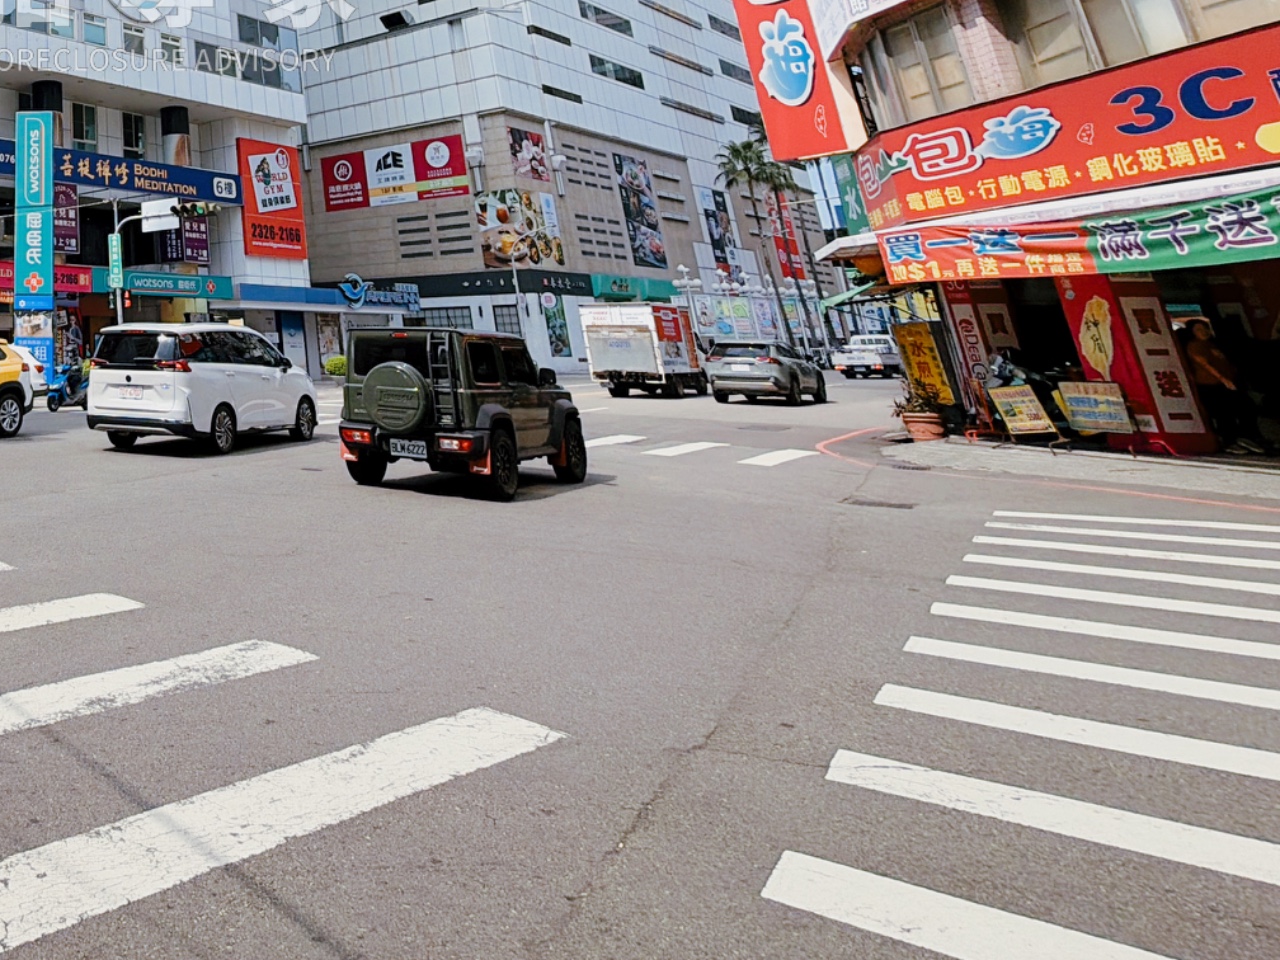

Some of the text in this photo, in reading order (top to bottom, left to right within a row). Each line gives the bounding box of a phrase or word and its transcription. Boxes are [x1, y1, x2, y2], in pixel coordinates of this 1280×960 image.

[1108, 65, 1280, 137] 3C
[29, 129, 40, 194] watsons
[59, 153, 131, 186] 菩提禪修
[133, 163, 168, 180] BODHI
[375, 150, 405, 173] ACE
[905, 135, 1228, 212] 電腦包 行動電源 鋼化玻璃貼
[133, 177, 198, 196] MEDITATION
[215, 180, 234, 196] 6樓
[251, 222, 302, 243] 2326-2166
[1087, 199, 1280, 262] 滿千送
[883, 227, 1080, 263] 買一送一
[133, 278, 174, 289] watsons
